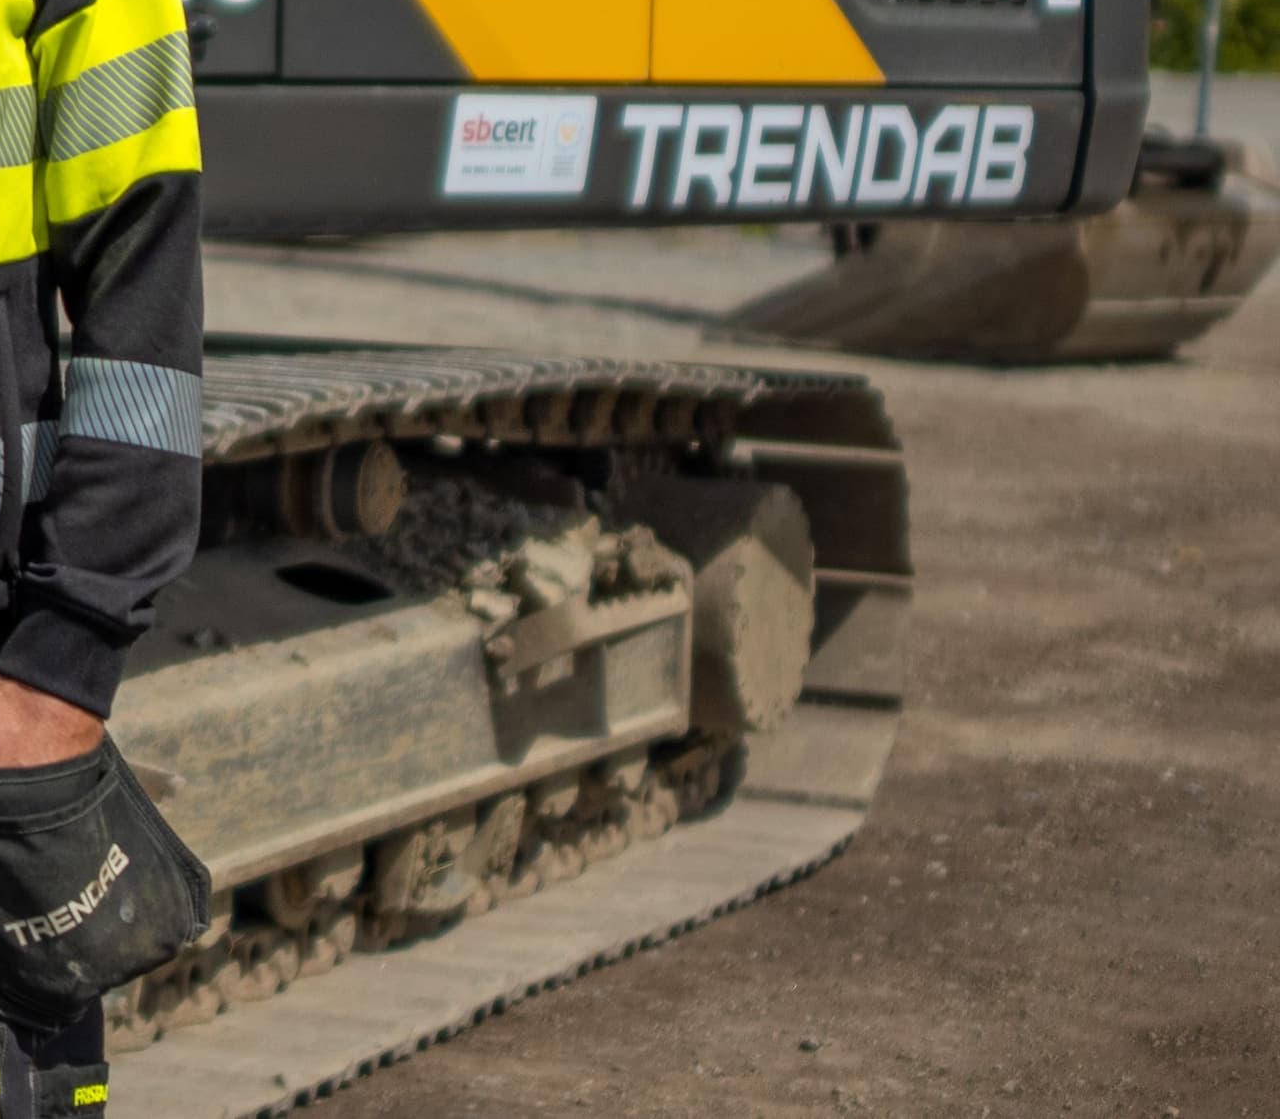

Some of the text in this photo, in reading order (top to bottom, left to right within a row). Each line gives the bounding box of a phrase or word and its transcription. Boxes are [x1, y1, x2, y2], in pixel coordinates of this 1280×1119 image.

[462, 111, 537, 143] sbcert
[622, 103, 1034, 207] TRENDAB
[3, 843, 130, 947] TRENDAB
